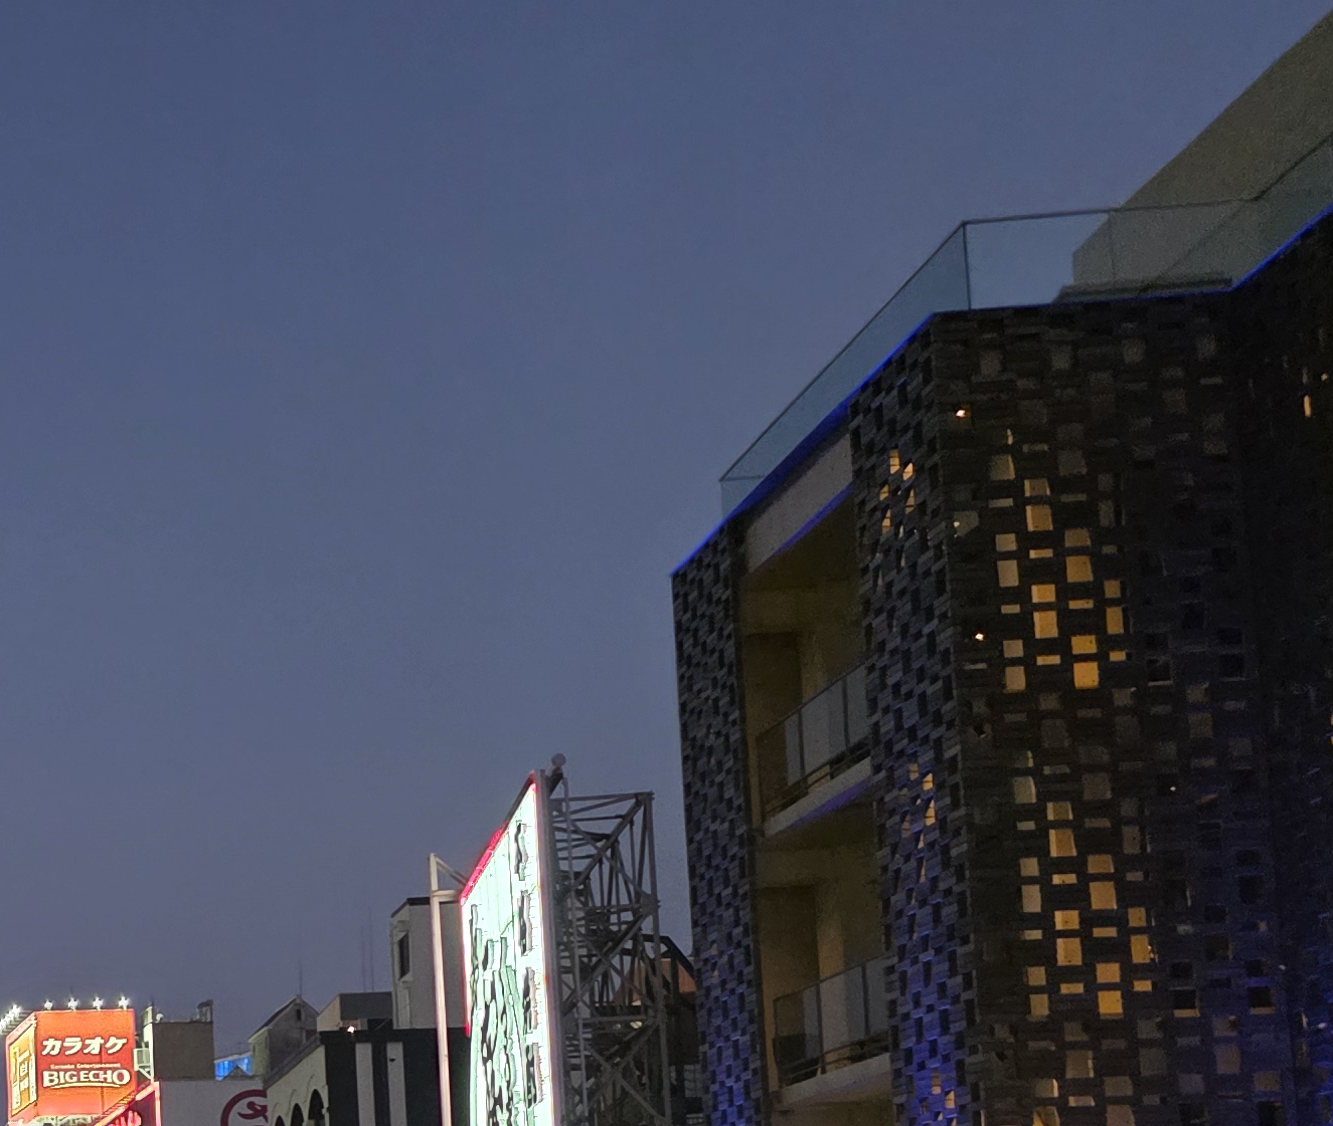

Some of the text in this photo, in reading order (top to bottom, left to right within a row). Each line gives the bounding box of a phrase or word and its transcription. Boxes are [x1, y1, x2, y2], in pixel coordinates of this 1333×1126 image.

[41, 1036, 128, 1056] カラオケ
[42, 1069, 131, 1088] BIG ECHO
